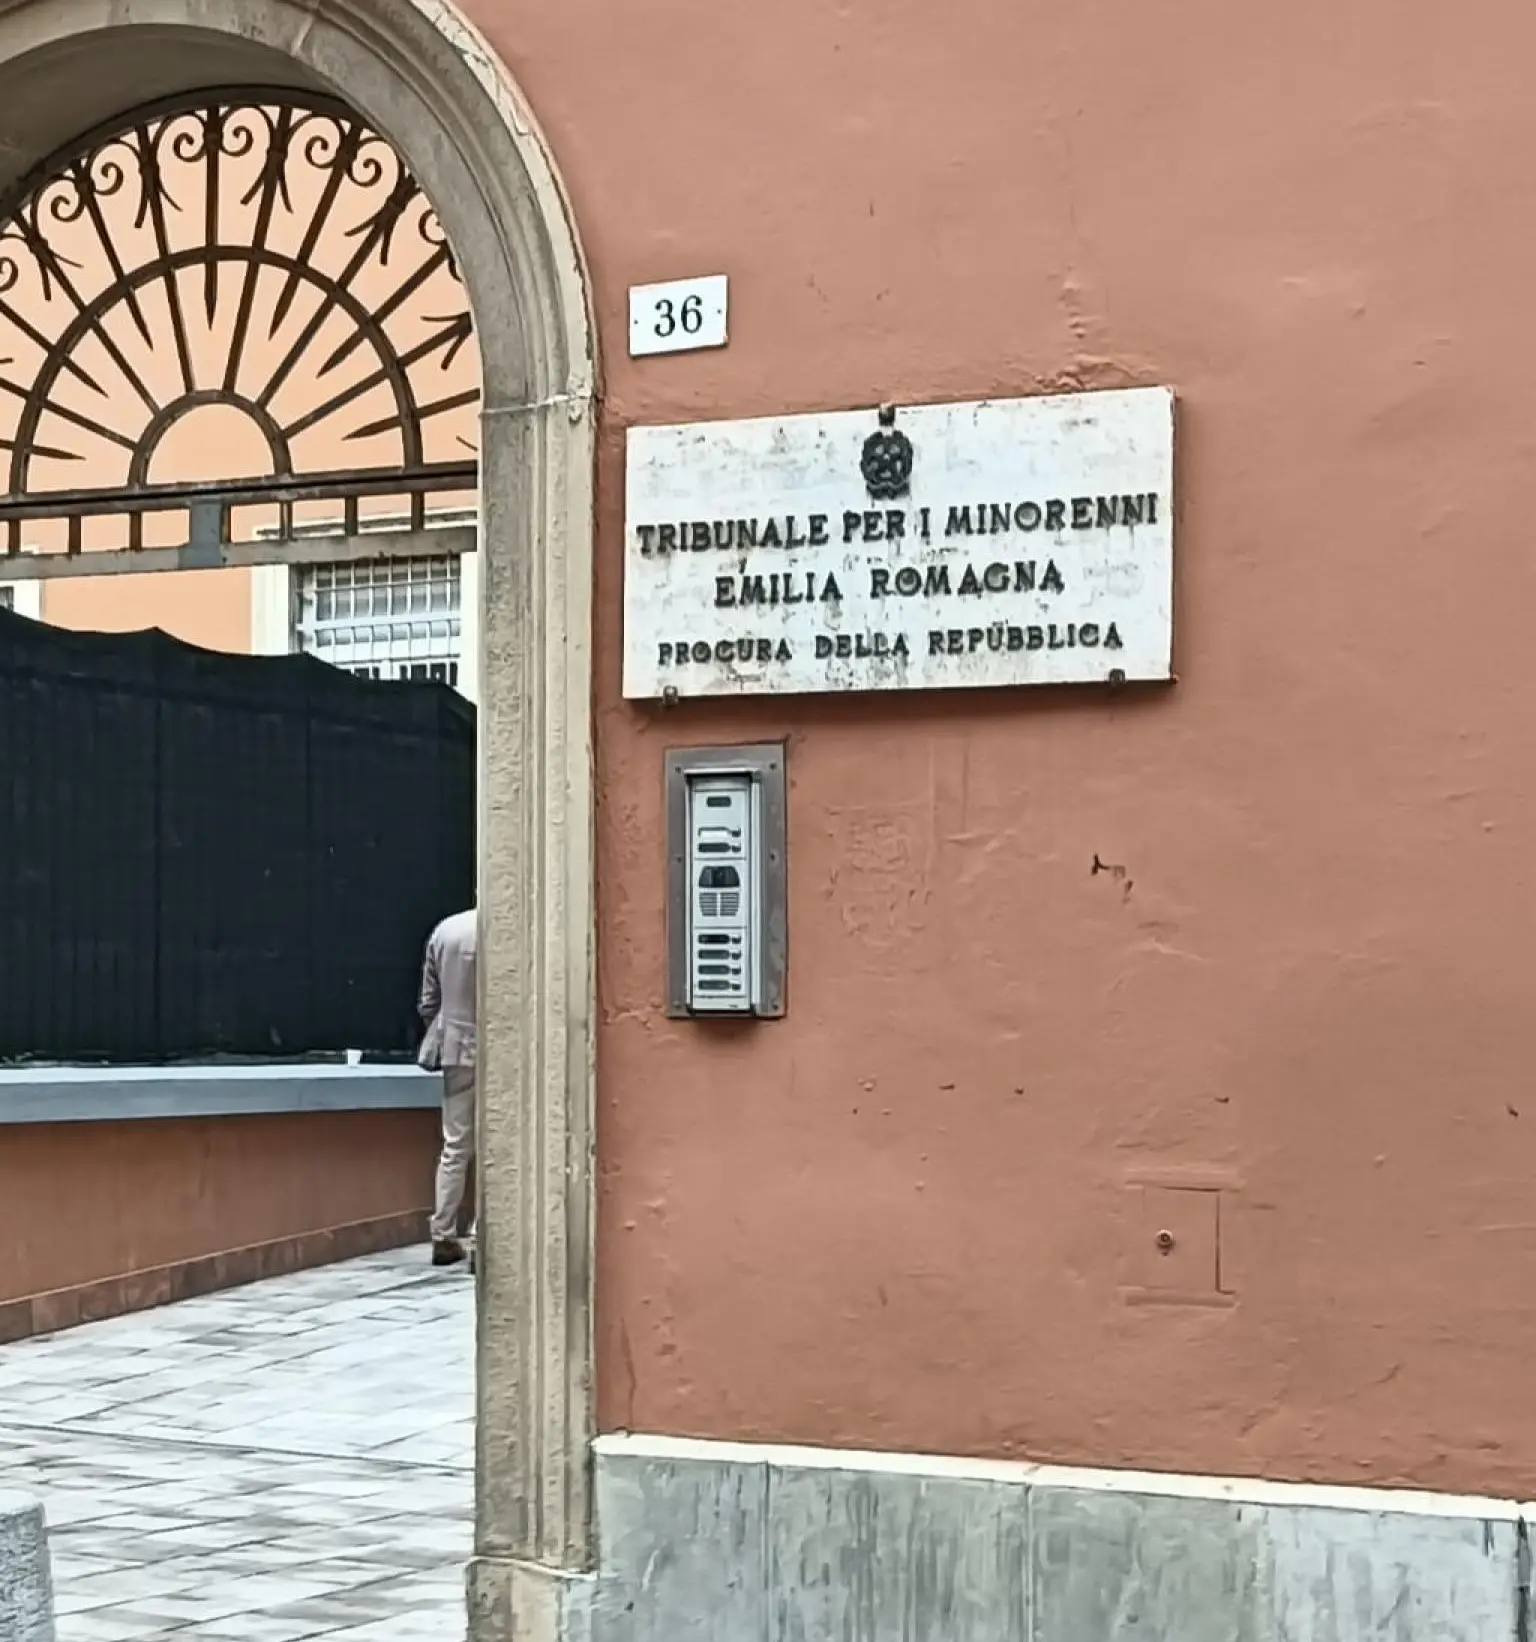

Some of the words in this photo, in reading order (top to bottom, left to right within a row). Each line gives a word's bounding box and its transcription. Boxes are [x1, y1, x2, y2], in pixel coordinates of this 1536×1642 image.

[654, 294, 703, 337] 36
[636, 514, 829, 556] TRIBUNALE
[842, 509, 906, 543] PER
[920, 507, 932, 539] I
[945, 493, 1159, 538] MINORENNI
[714, 571, 843, 609] EMILIA
[869, 559, 1065, 600] ROMAGNA
[658, 636, 793, 667] PROCURA
[814, 630, 910, 660] DELLA
[928, 622, 1124, 657] REPUBBLICA
